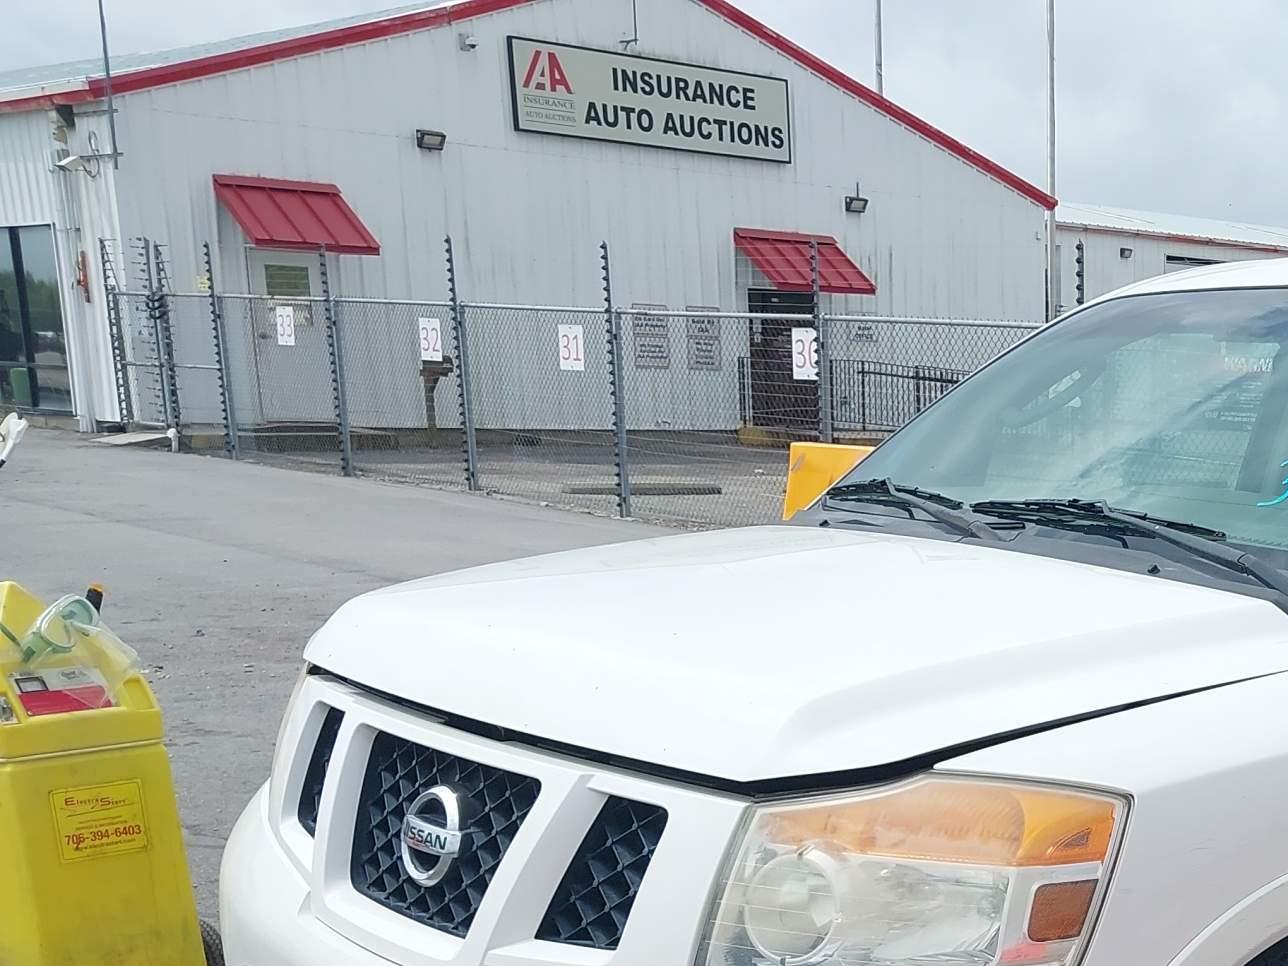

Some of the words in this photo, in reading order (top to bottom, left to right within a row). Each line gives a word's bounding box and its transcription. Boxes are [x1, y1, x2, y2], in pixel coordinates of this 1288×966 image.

[612, 67, 756, 110] INSURANCE
[523, 96, 573, 109] INSURANCE
[584, 102, 654, 132] AUTO
[662, 112, 784, 149] AUCTIONS
[278, 314, 293, 337] 33
[421, 327, 440, 352] 32
[561, 333, 582, 361] 31
